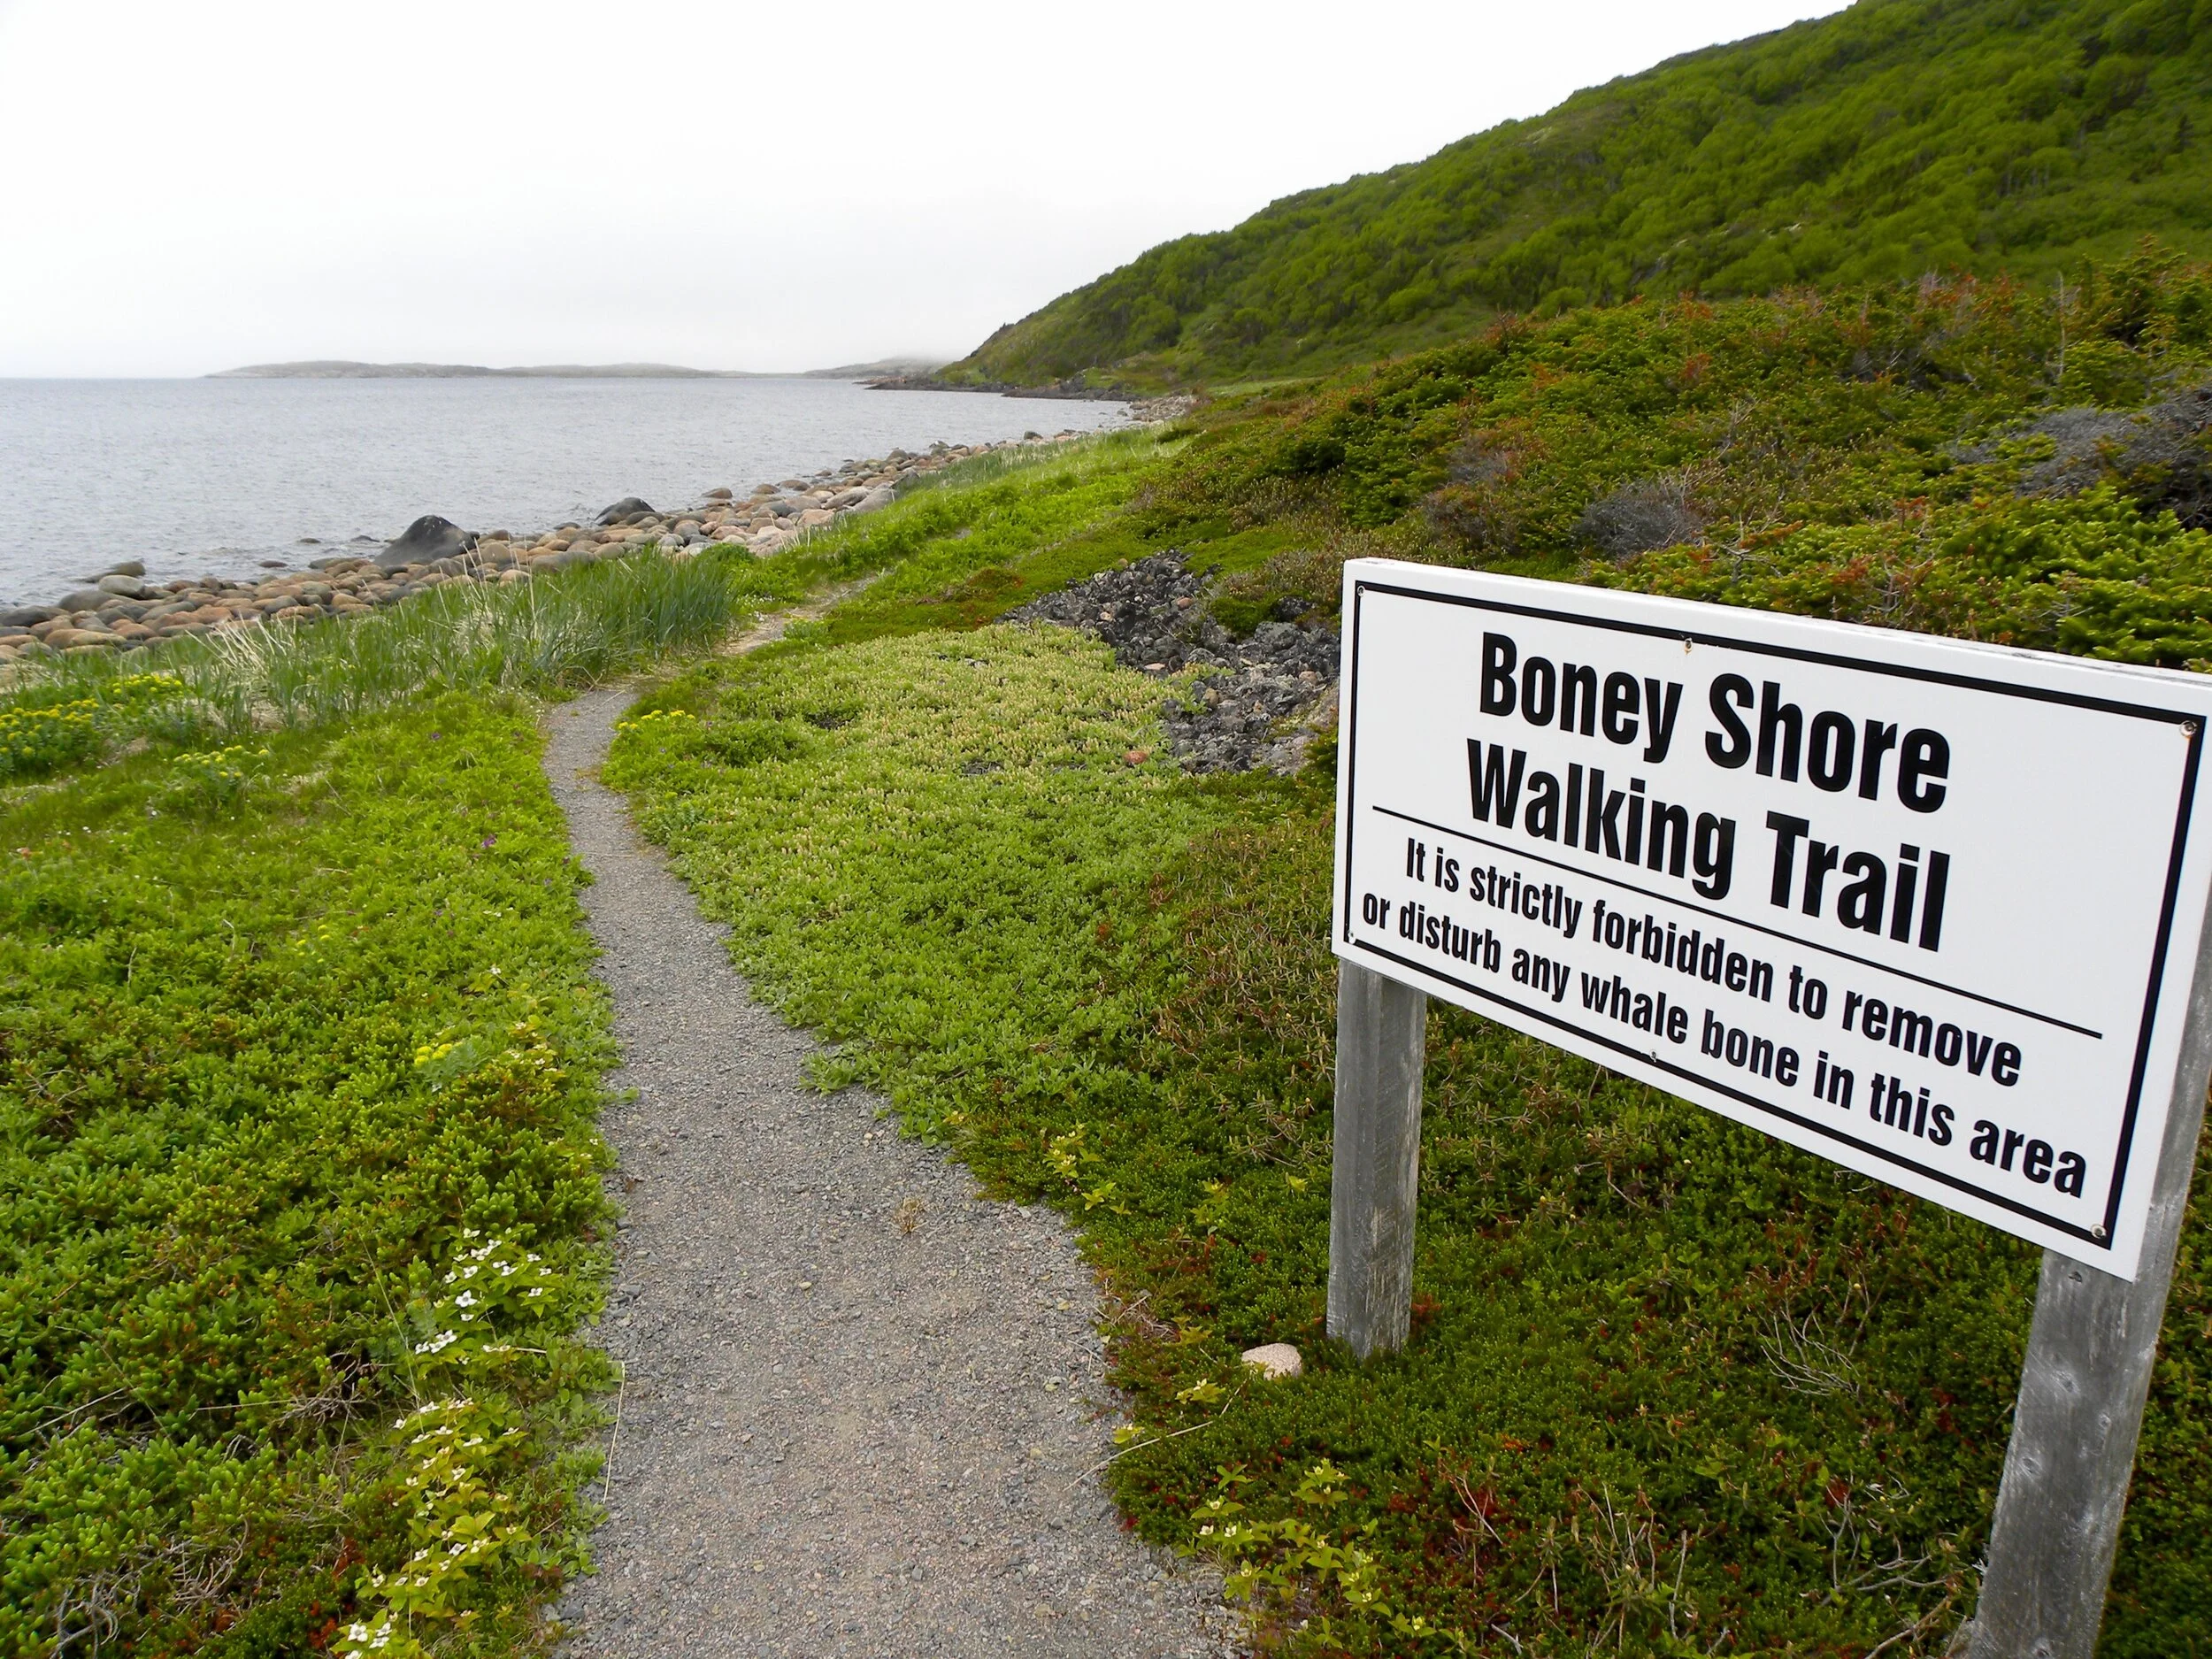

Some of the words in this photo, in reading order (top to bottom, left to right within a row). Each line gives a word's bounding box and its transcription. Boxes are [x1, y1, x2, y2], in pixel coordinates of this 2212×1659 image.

[1479, 631, 1684, 764] Boney
[1704, 672, 1950, 814] Shore
[1466, 738, 1737, 904] Walking
[1765, 810, 1951, 953] Trail
[1363, 893, 1391, 930] or
[1399, 901, 1502, 973] disturb
[1511, 948, 1571, 1003] any
[1580, 972, 1689, 1044] whale
[1701, 1008, 1800, 1087] bone
[1813, 1049, 1855, 1110] in
[1870, 1072, 1955, 1147] this
[1970, 1119, 2086, 1199] area
[1406, 837, 1426, 883] It
[1434, 846, 1460, 893] is
[1469, 865, 1583, 939] strictly
[1592, 899, 1774, 1003] forbidden
[1788, 964, 1828, 1020] to
[1841, 990, 2022, 1087] remove
